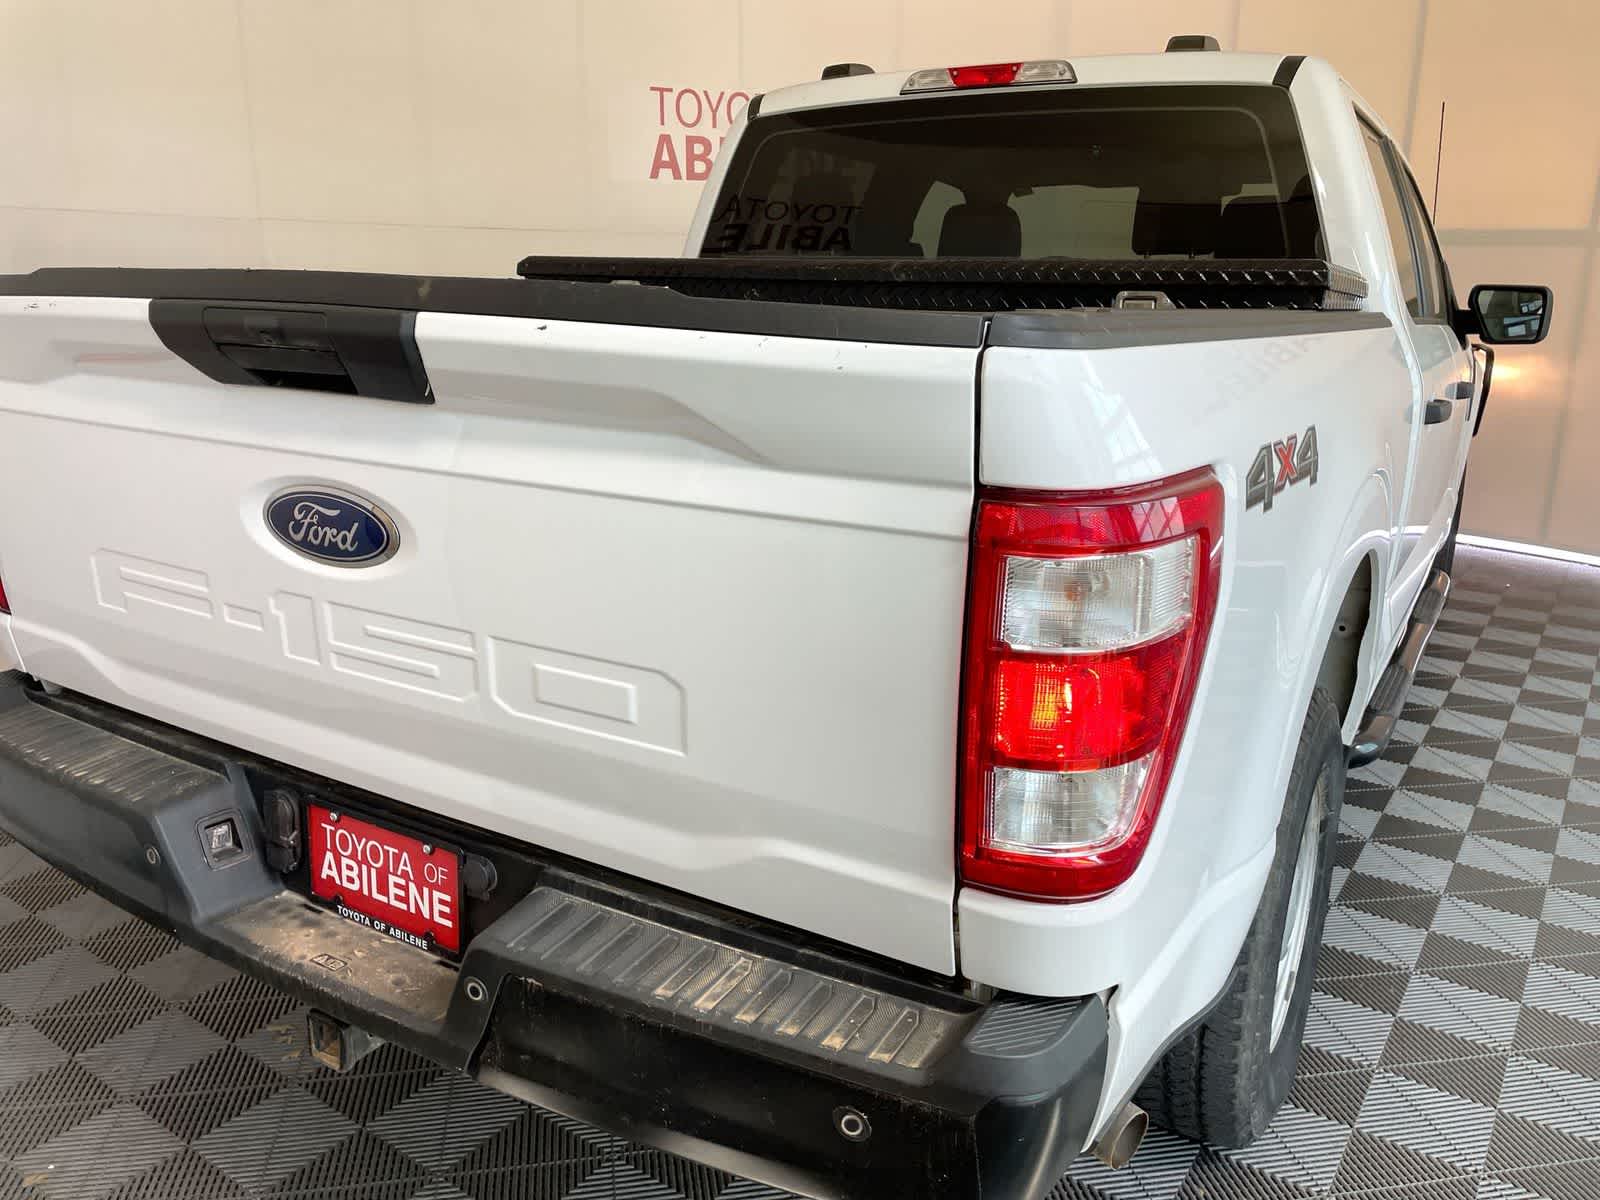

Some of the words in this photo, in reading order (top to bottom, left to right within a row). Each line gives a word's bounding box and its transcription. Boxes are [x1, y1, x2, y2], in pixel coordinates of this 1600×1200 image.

[649, 86, 758, 128] TOYO
[649, 134, 726, 181] AB
[288, 501, 359, 552] Ford
[91, 548, 688, 757] F-150
[321, 823, 414, 880] TOYOTA
[424, 863, 448, 885] OF
[320, 851, 453, 928] ABILENE
[336, 905, 371, 927] TOYOTA
[373, 920, 387, 932] OF
[389, 927, 428, 951] ABILENE
